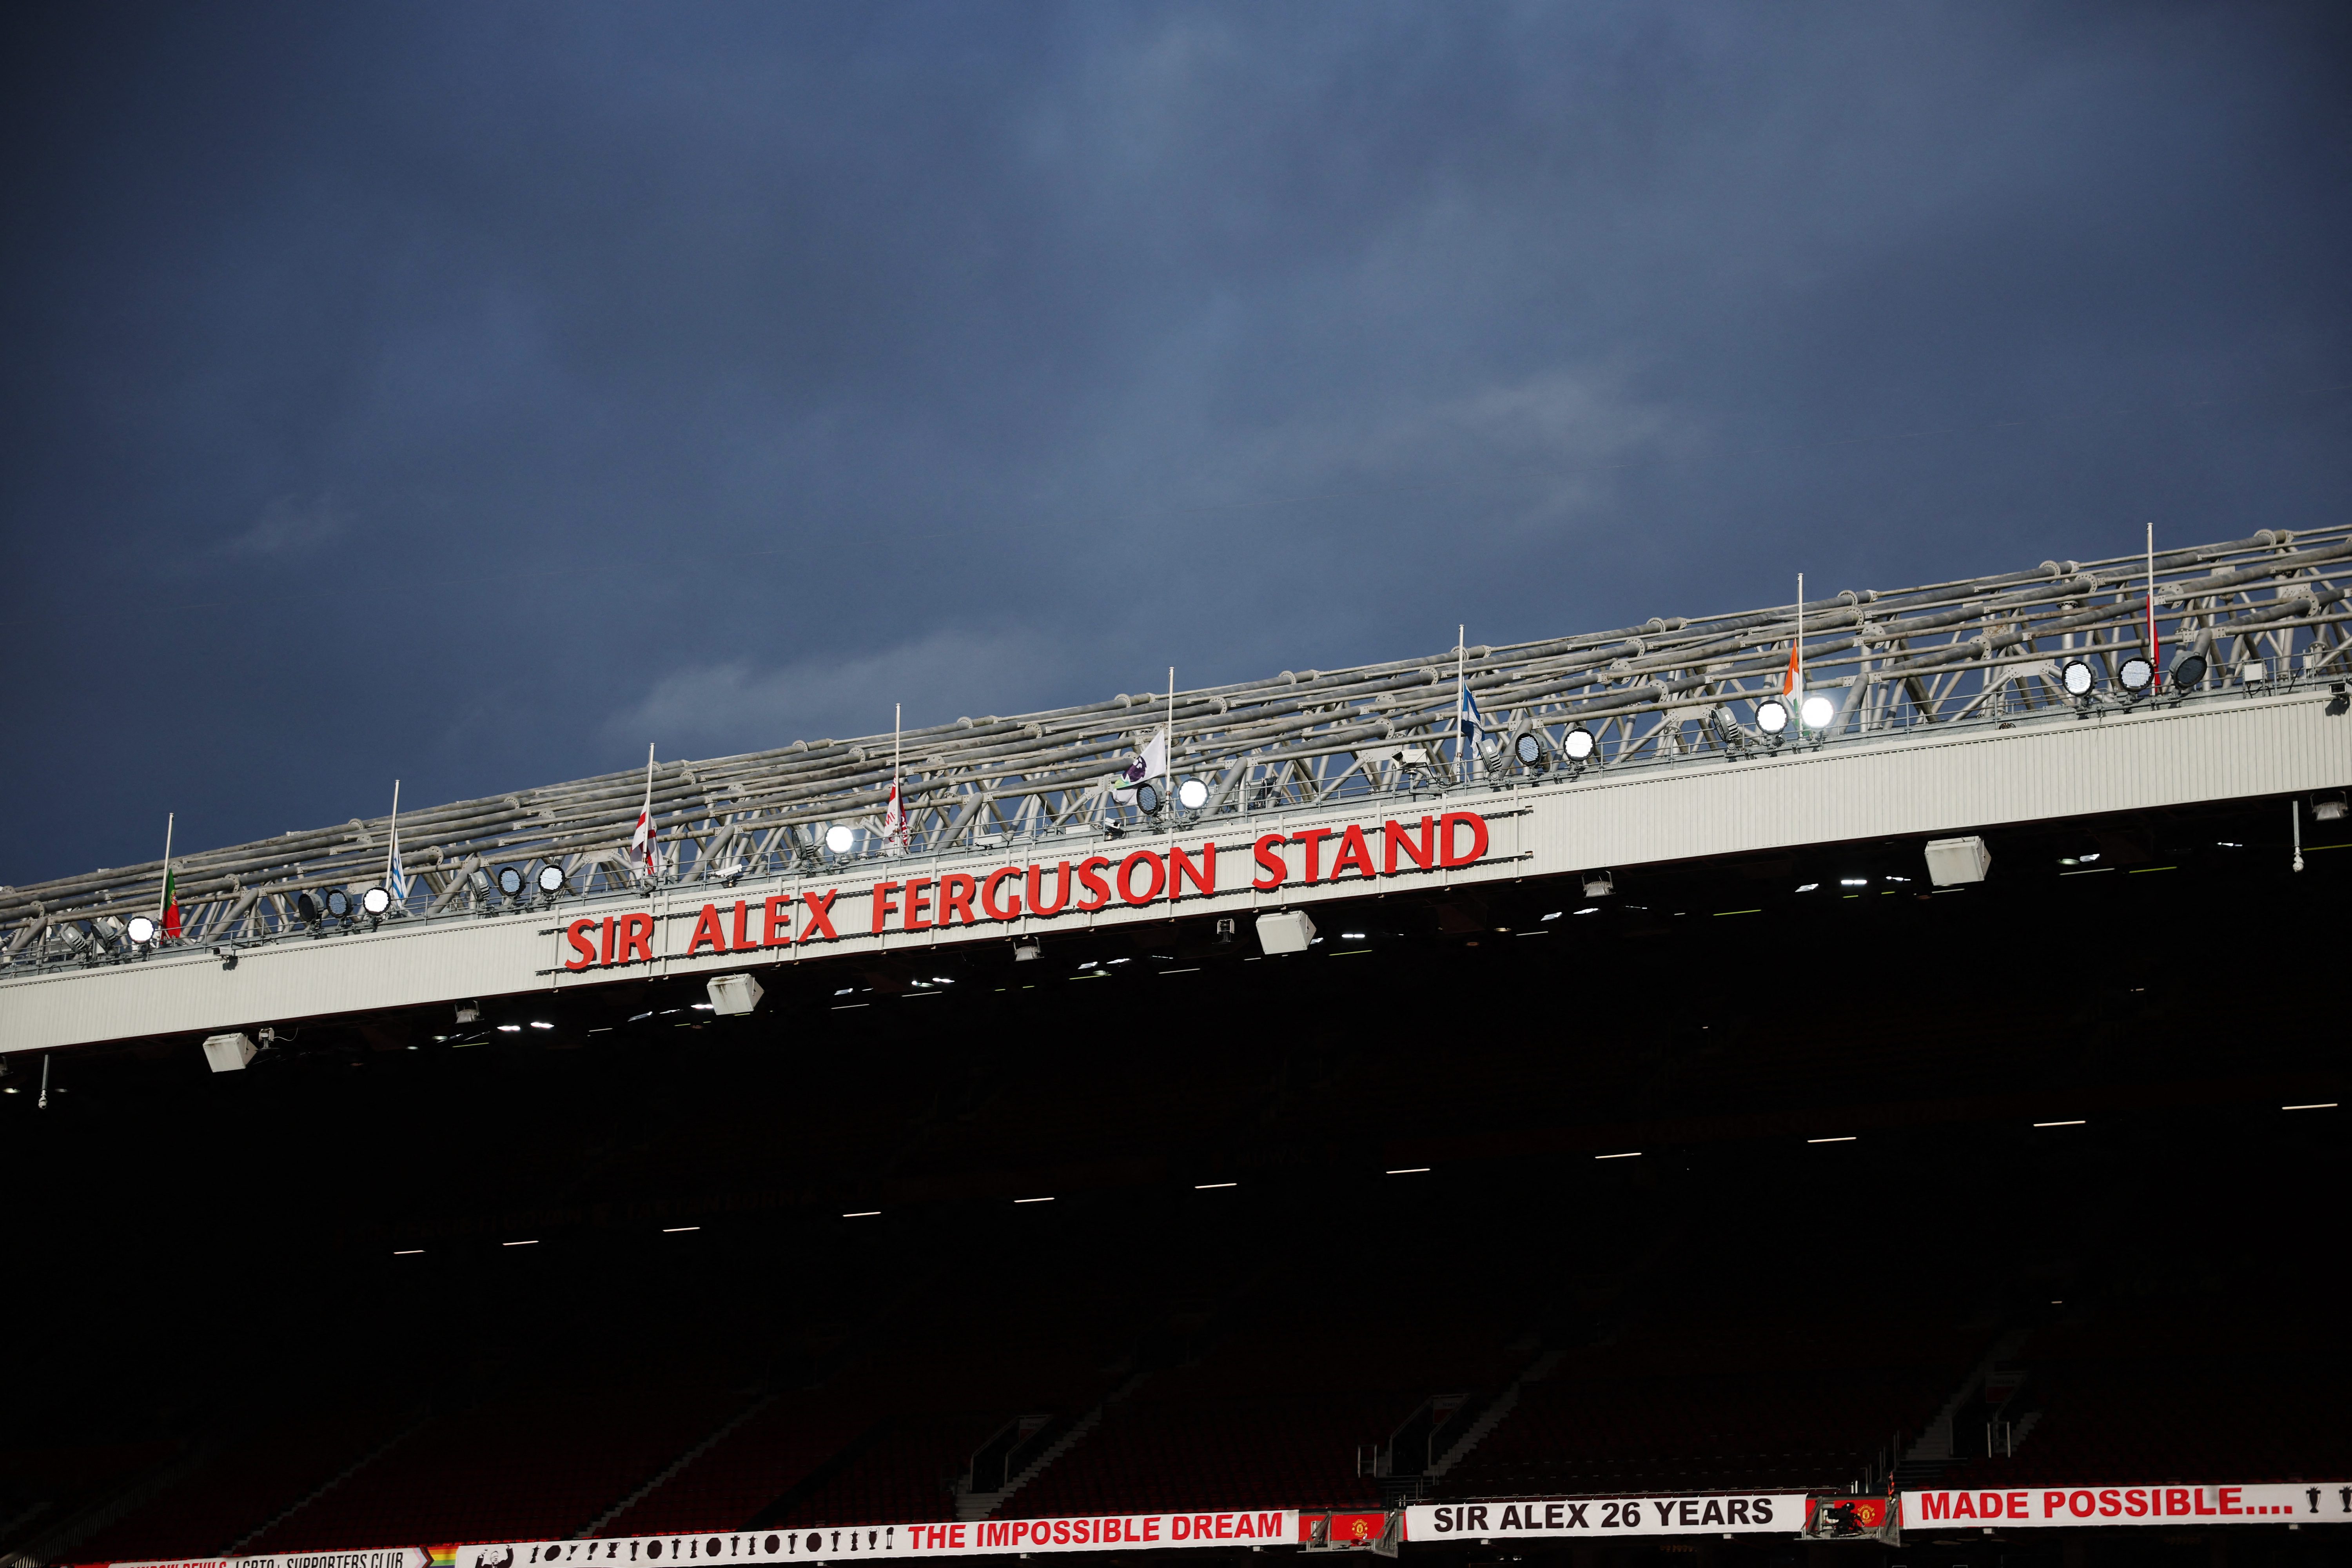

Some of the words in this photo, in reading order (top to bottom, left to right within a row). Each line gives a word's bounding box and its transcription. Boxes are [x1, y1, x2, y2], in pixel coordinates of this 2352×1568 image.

[564, 913, 653, 969] SIR
[686, 888, 839, 955] ALEX
[871, 842, 1216, 933] FERGUSON
[1252, 811, 1489, 889] STAND
[1434, 1506, 1490, 1532] SIR
[1499, 1503, 1590, 1530] ALEX
[1601, 1502, 1641, 1528] 26
[1653, 1498, 1773, 1526] YEARS
[1921, 1492, 2029, 1520] MADE
[2043, 1487, 2293, 1518] POSSIBLE....
[907, 1524, 967, 1550] THE
[976, 1517, 1161, 1548] IMPOSSIBLE
[1171, 1512, 1283, 1541] DREAM
[371, 1552, 403, 1568] CLUB
